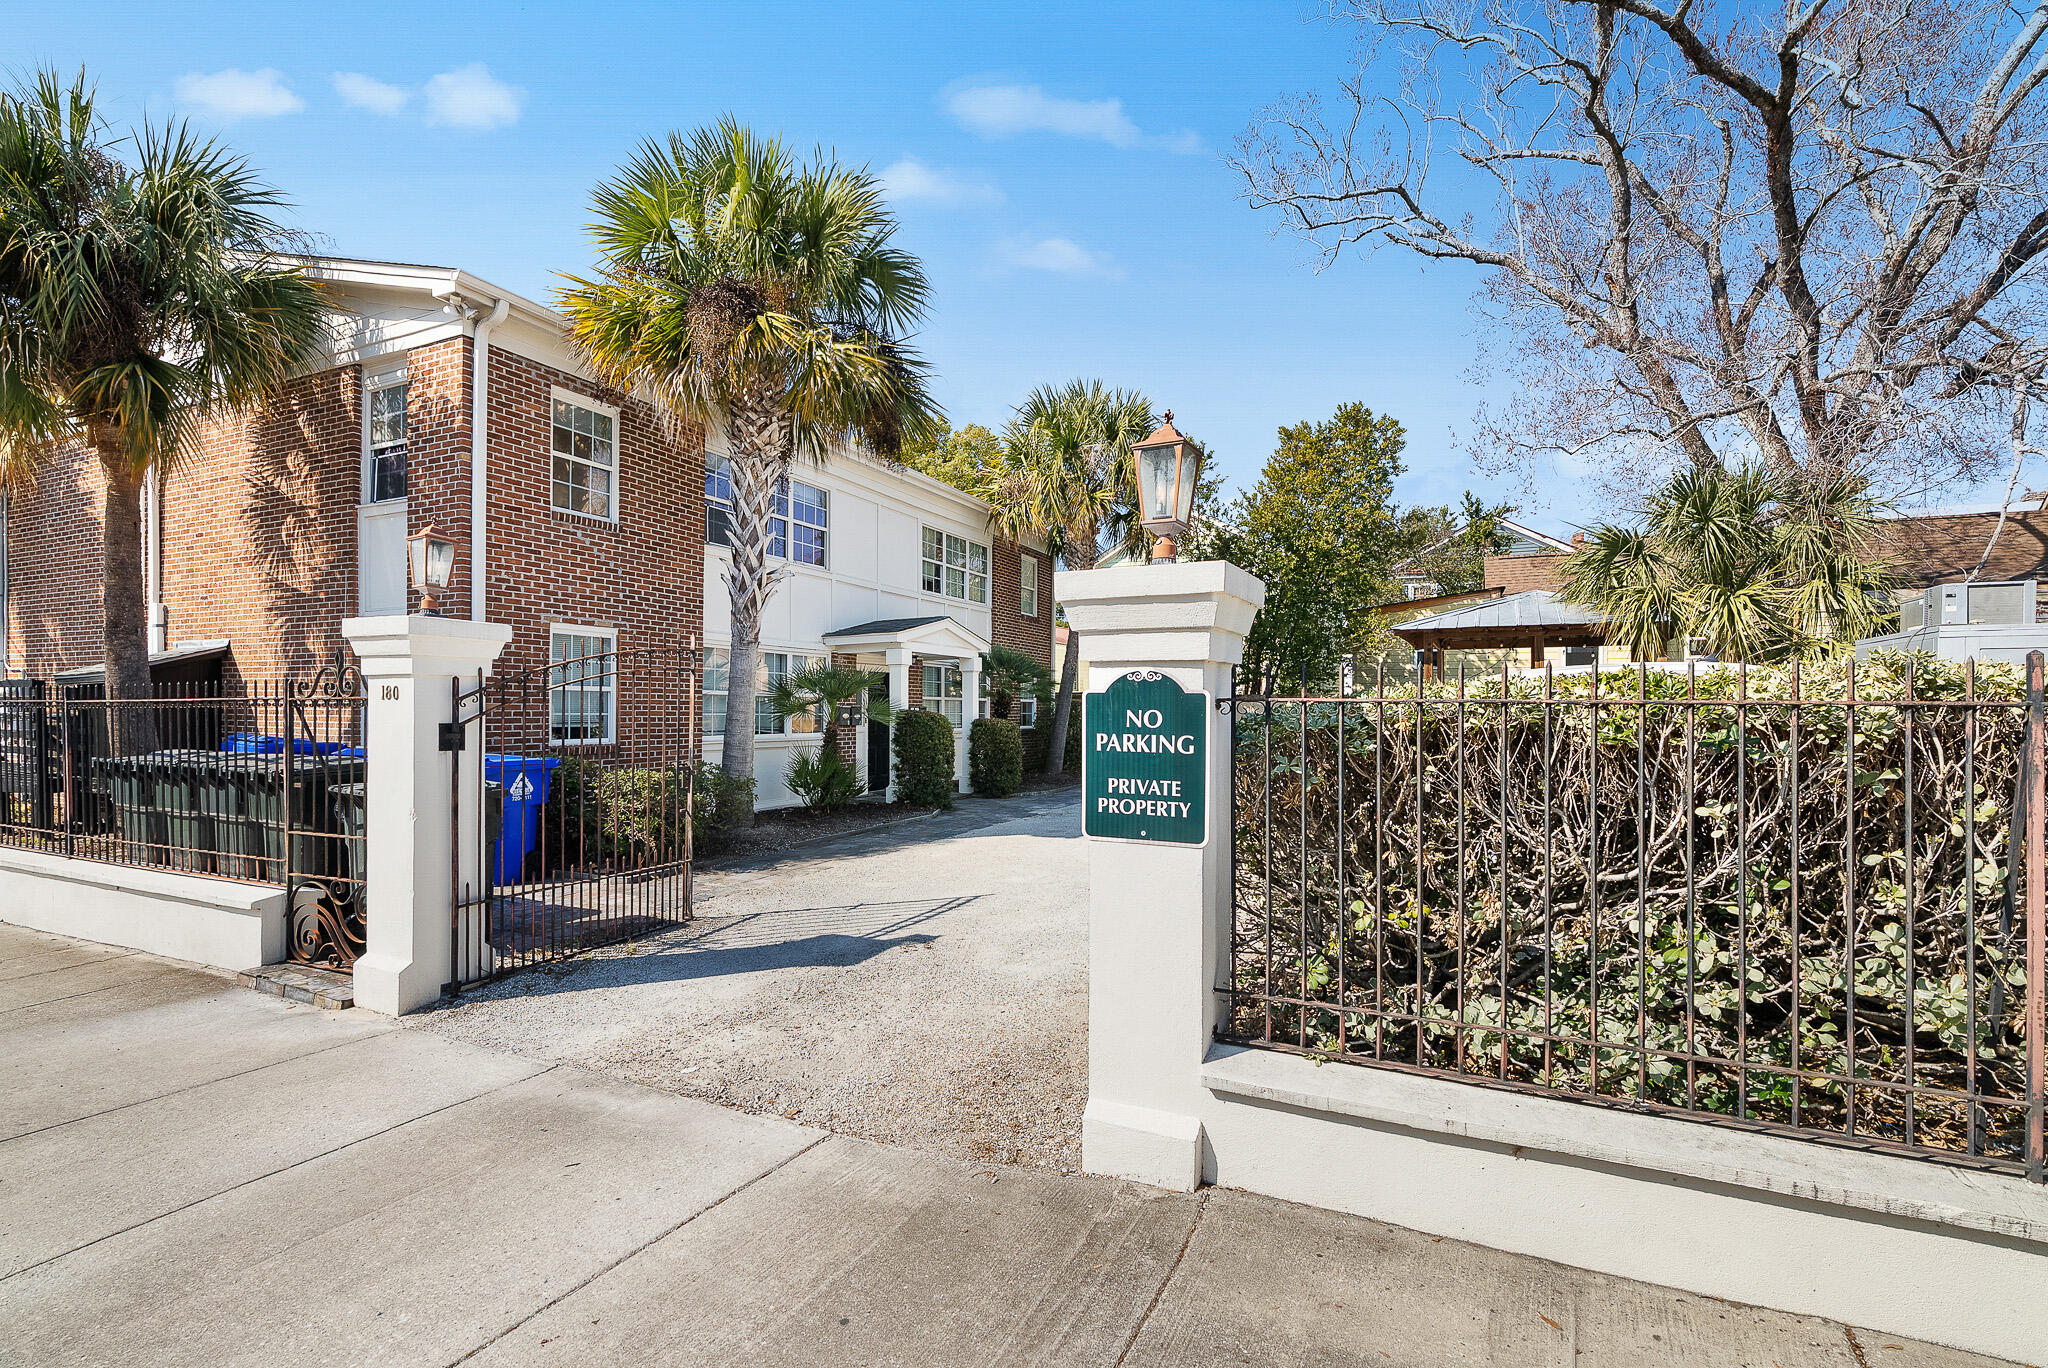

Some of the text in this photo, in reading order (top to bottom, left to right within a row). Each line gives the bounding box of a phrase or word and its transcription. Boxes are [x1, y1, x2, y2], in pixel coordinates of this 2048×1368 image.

[381, 685, 399, 700] 180
[1126, 709, 1163, 728] NO
[1096, 733, 1195, 755] PARKING
[1108, 778, 1181, 797] PRIVATE
[1098, 798, 1191, 818] PROPERTY
